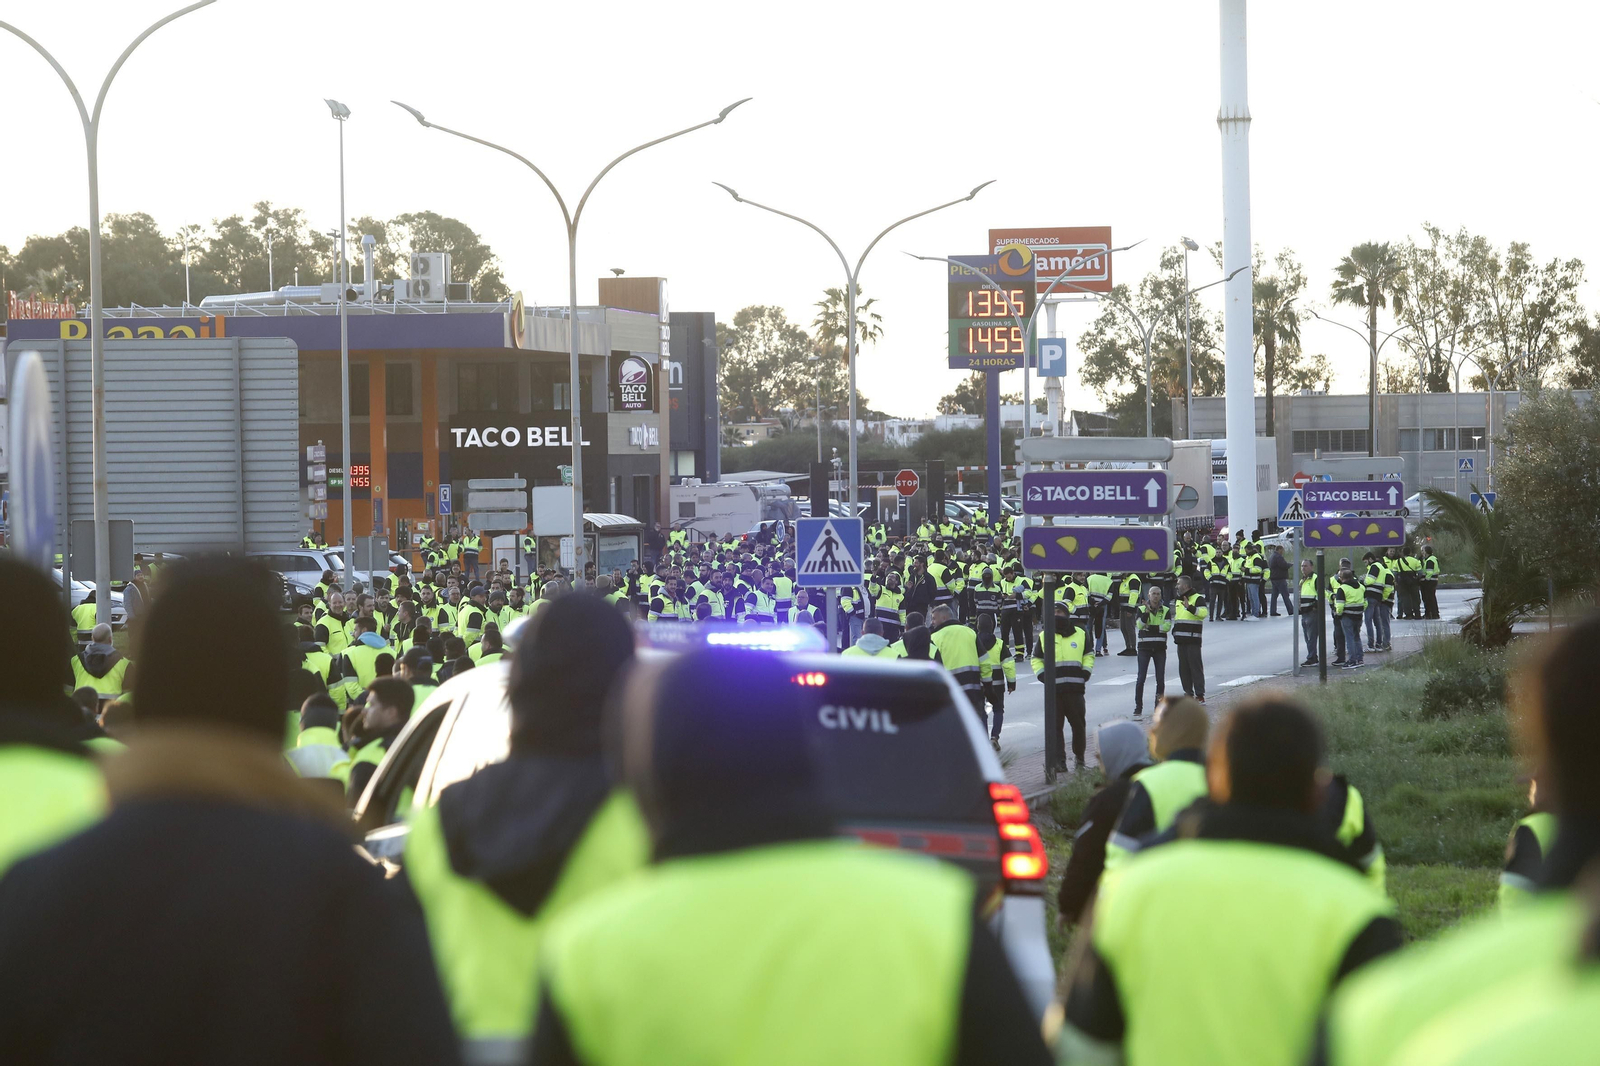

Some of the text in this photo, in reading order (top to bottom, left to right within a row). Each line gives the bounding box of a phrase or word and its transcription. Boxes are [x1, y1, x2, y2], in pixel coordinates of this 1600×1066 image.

[996, 237, 1060, 246] SUPERMERCADOS
[1036, 248, 1101, 271] amón
[968, 289, 1024, 317] 1.395
[983, 358, 1016, 366] HORAS
[1042, 344, 1063, 369] P
[620, 385, 647, 393] TACO
[622, 394, 647, 402] BELL
[450, 426, 591, 448] TACO BELL
[1043, 485, 1136, 501] TACO BELL
[1317, 490, 1381, 501] TACO BELL
[818, 704, 899, 734] CIVIL
